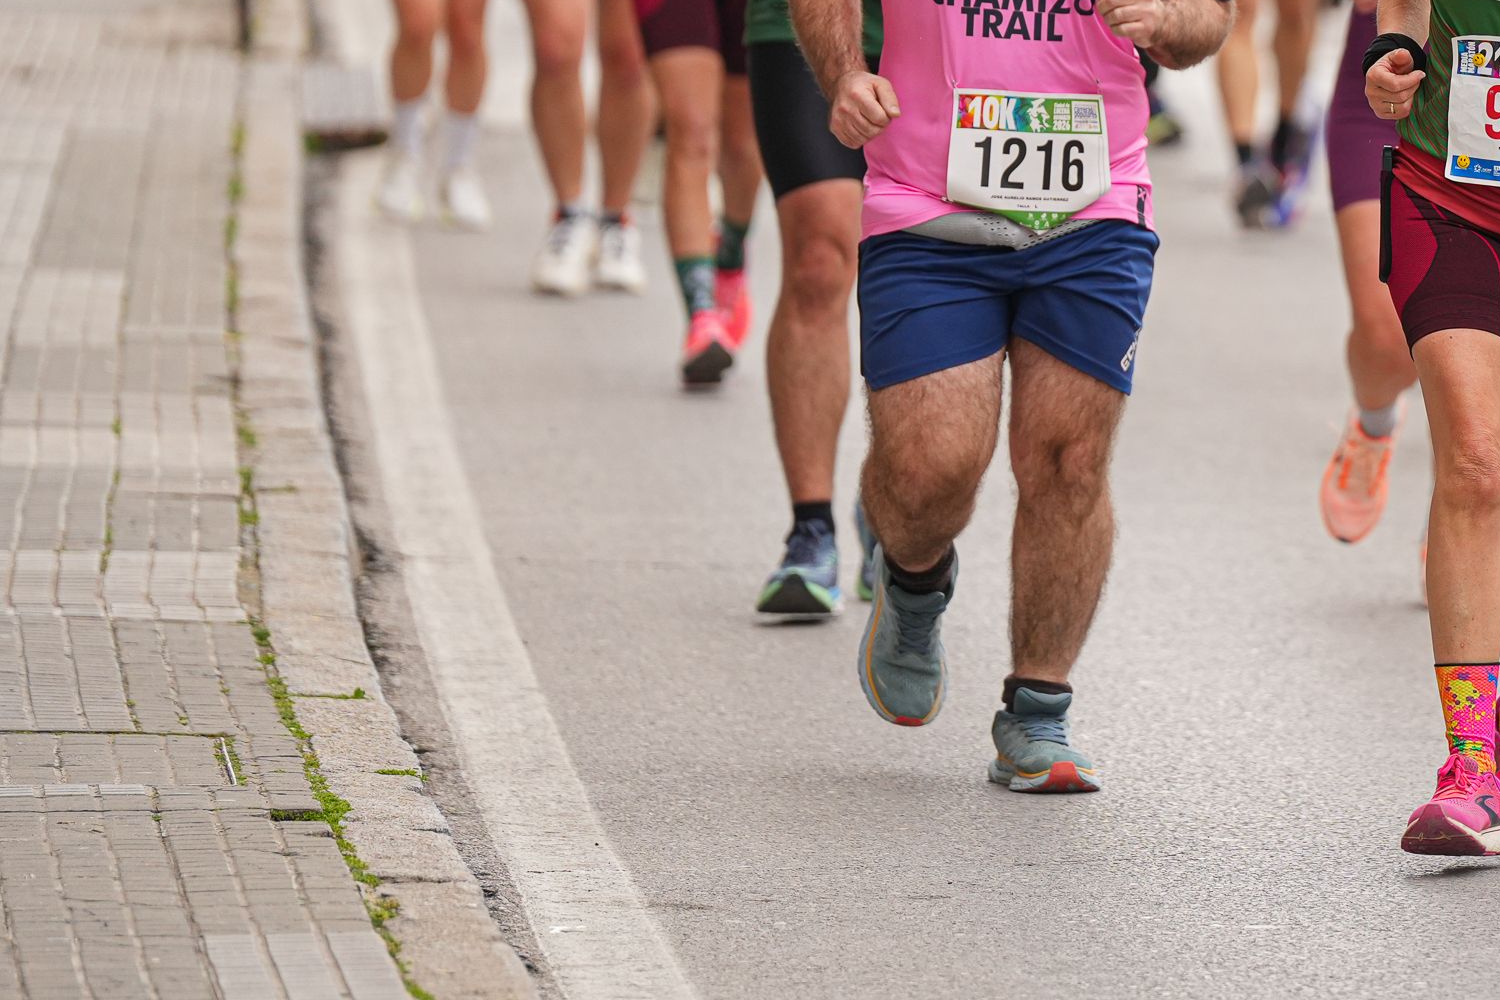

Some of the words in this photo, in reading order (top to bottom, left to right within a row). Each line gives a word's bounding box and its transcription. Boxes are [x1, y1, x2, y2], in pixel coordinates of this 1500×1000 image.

[961, 6, 1063, 42] TRAIL
[968, 96, 1017, 131] 10K
[974, 136, 1084, 192] 1216
